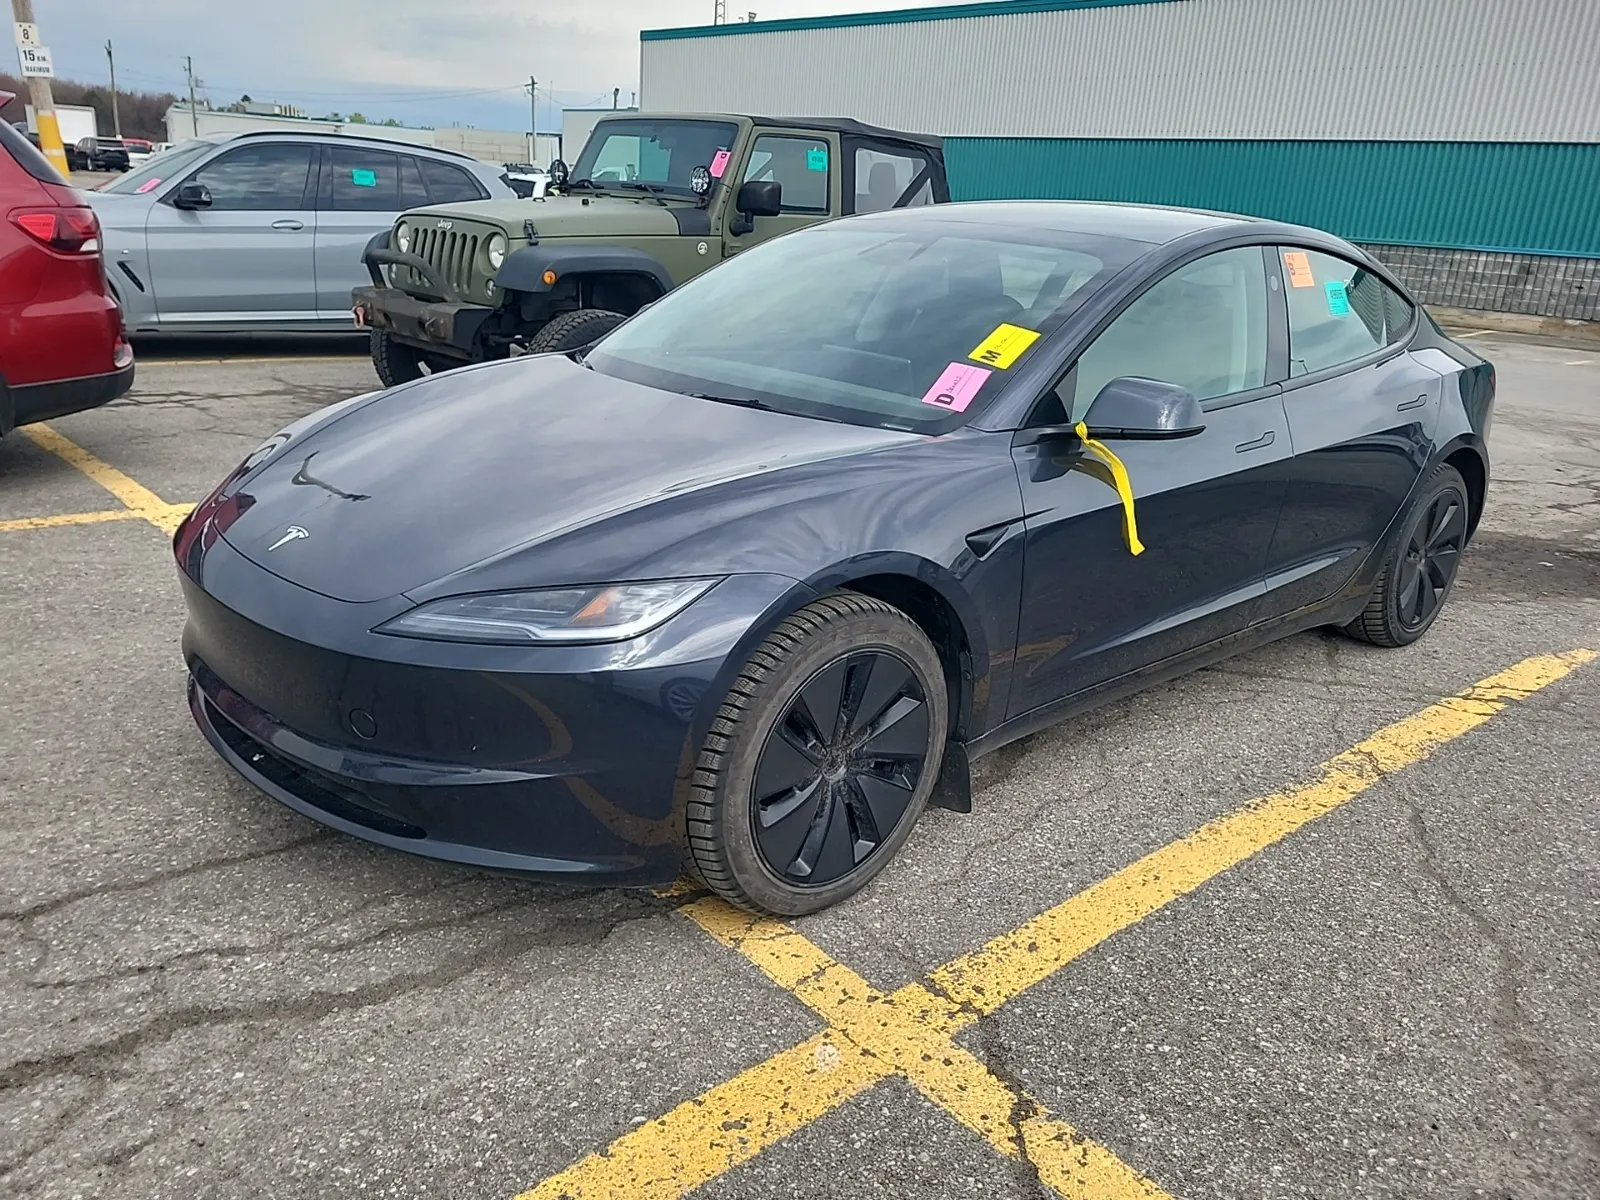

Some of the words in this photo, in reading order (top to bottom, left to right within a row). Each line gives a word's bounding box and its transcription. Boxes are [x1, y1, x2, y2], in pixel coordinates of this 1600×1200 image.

[22, 28, 30, 40] 8
[22, 49, 36, 62] 15
[437, 218, 453, 230] Jeep
[1287, 262, 1296, 276] B
[979, 349, 1002, 363] M
[933, 393, 955, 406] D
